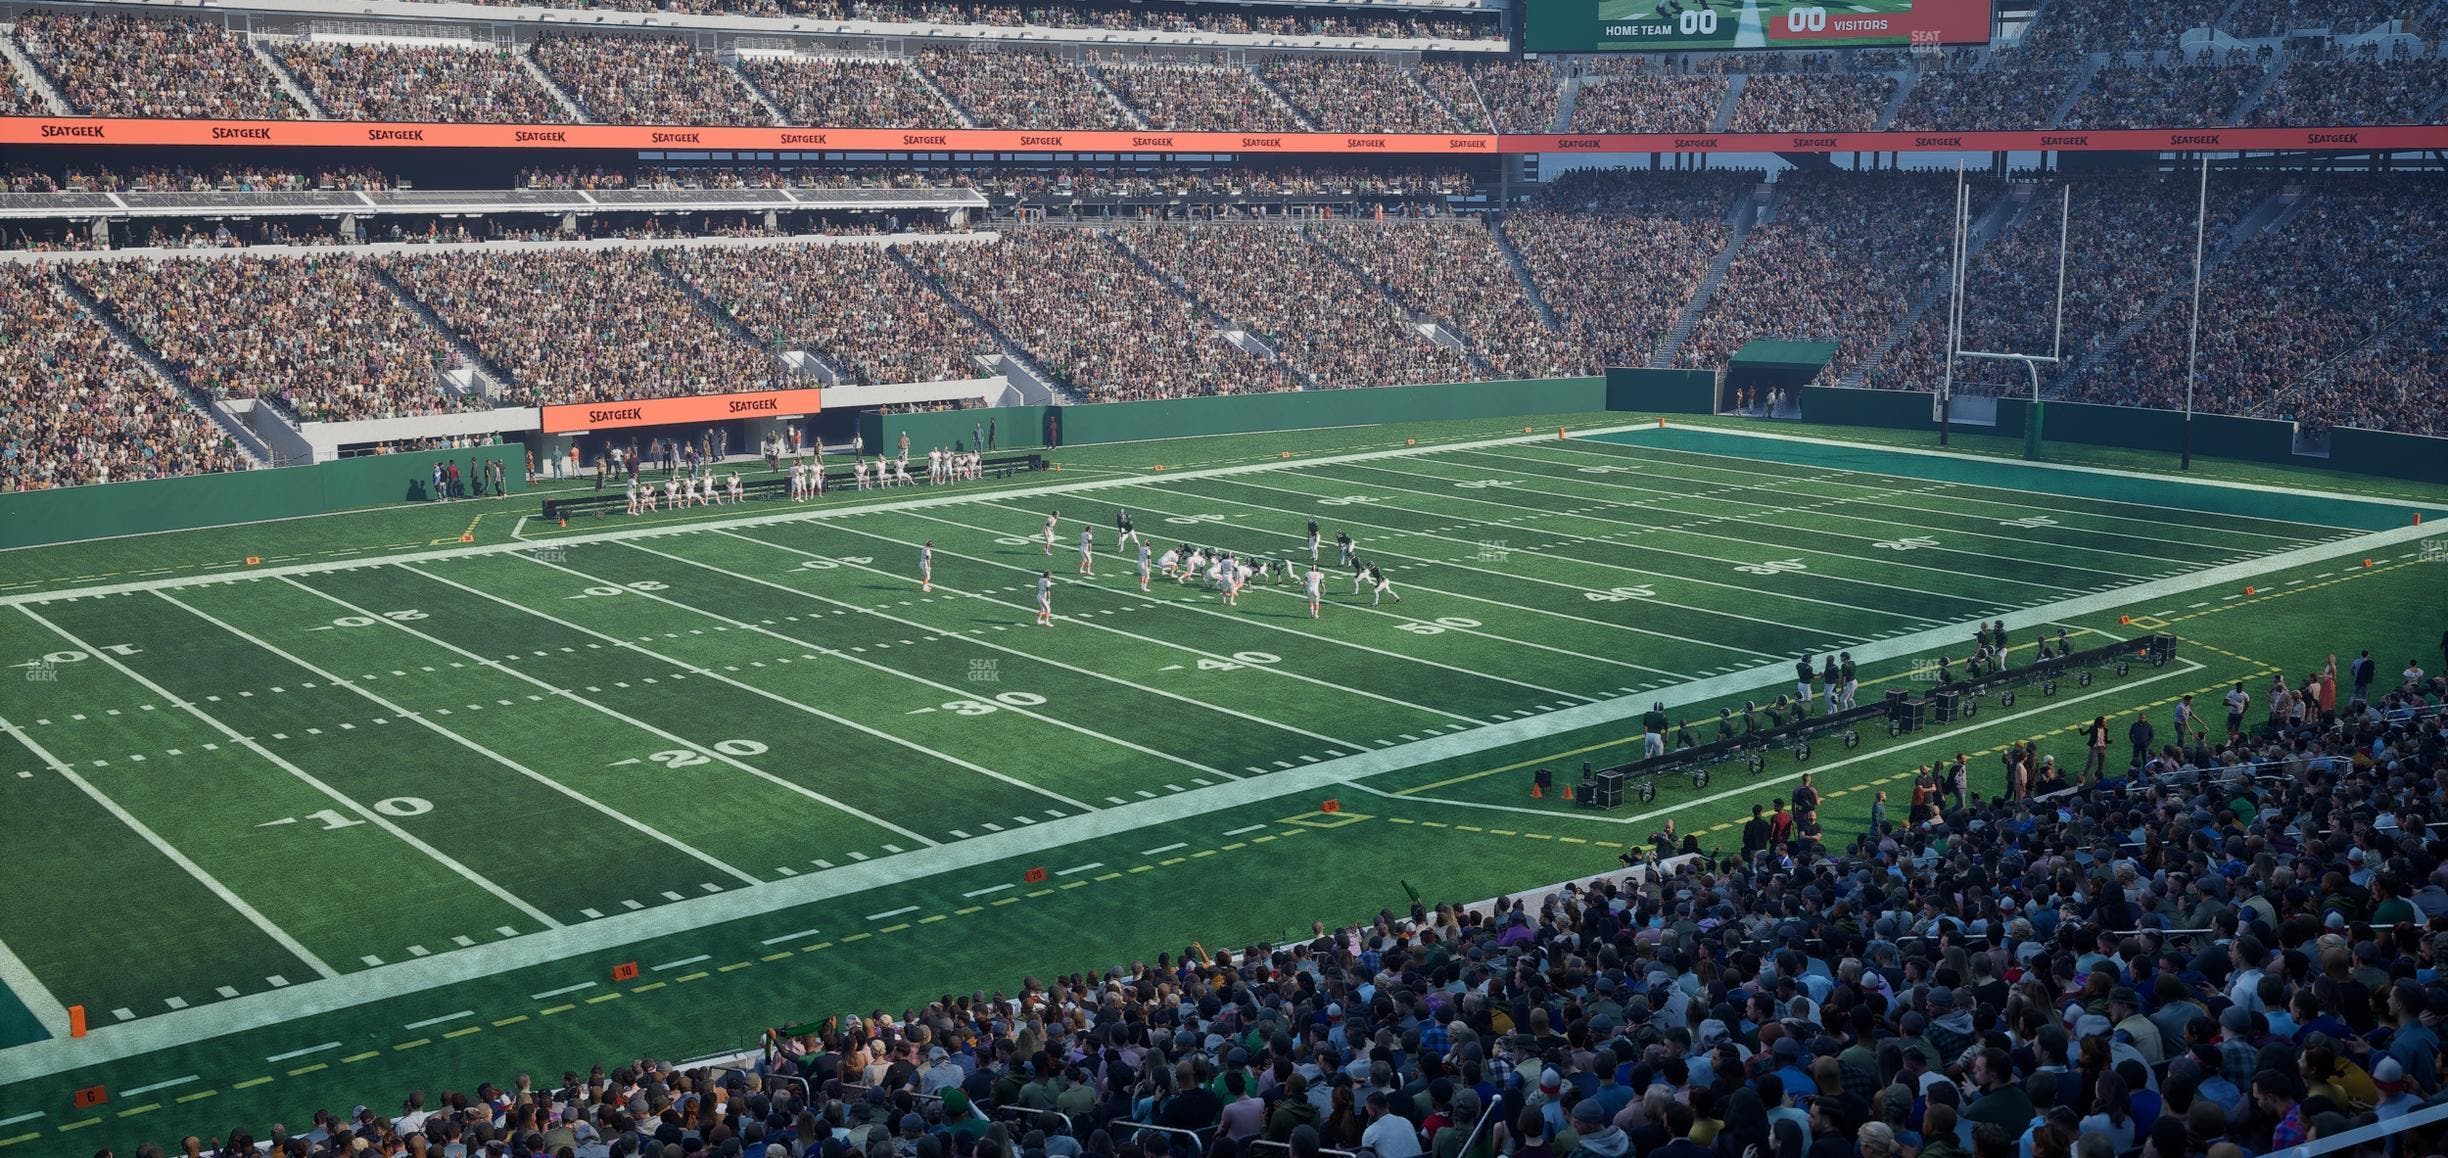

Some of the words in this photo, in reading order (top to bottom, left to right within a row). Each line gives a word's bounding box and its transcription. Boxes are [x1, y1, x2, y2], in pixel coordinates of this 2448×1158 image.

[1606, 25, 1638, 36] HOME
[1641, 24, 1672, 35] TEAM
[1680, 9, 1718, 35] 00
[1788, 6, 1826, 32] 00
[1834, 19, 1888, 31] VISITORS
[40, 124, 105, 138] SEATGEEK
[211, 127, 271, 140] SEATGEEK
[368, 129, 424, 141] SEATGEEK
[515, 130, 566, 143] SEATGEEK
[651, 132, 700, 144] SEATGEEK
[780, 133, 827, 145] SEATGEEK
[903, 134, 947, 146] SEATGEEK
[1020, 135, 1063, 147] SEATGEEK
[1132, 137, 1173, 147] SEATGEEK
[1242, 137, 1281, 148] SEATGEEK
[1347, 138, 1386, 148] SEATGEEK
[1449, 139, 1486, 149] SEATGEEK
[1558, 139, 1601, 149] SEATGEEK
[1674, 138, 1718, 149] SEATGEEK
[1793, 137, 1838, 148] SEATGEEK
[1914, 137, 1962, 147] SEATGEEK
[2040, 136, 2088, 146] SEATGEEK
[2170, 134, 2220, 145] SEATGEEK
[2307, 132, 2358, 145] SEATGEEK
[729, 398, 778, 414] SEATGEEK
[589, 407, 642, 424] SEATGEEK
[1583, 587, 1656, 602] 40
[1393, 617, 1482, 635] 50
[1197, 652, 1281, 671] 40
[941, 692, 1047, 715] 30
[648, 739, 768, 769] 20
[305, 797, 434, 830] 10
[621, 965, 632, 977] 10
[87, 1090, 96, 1103] G
